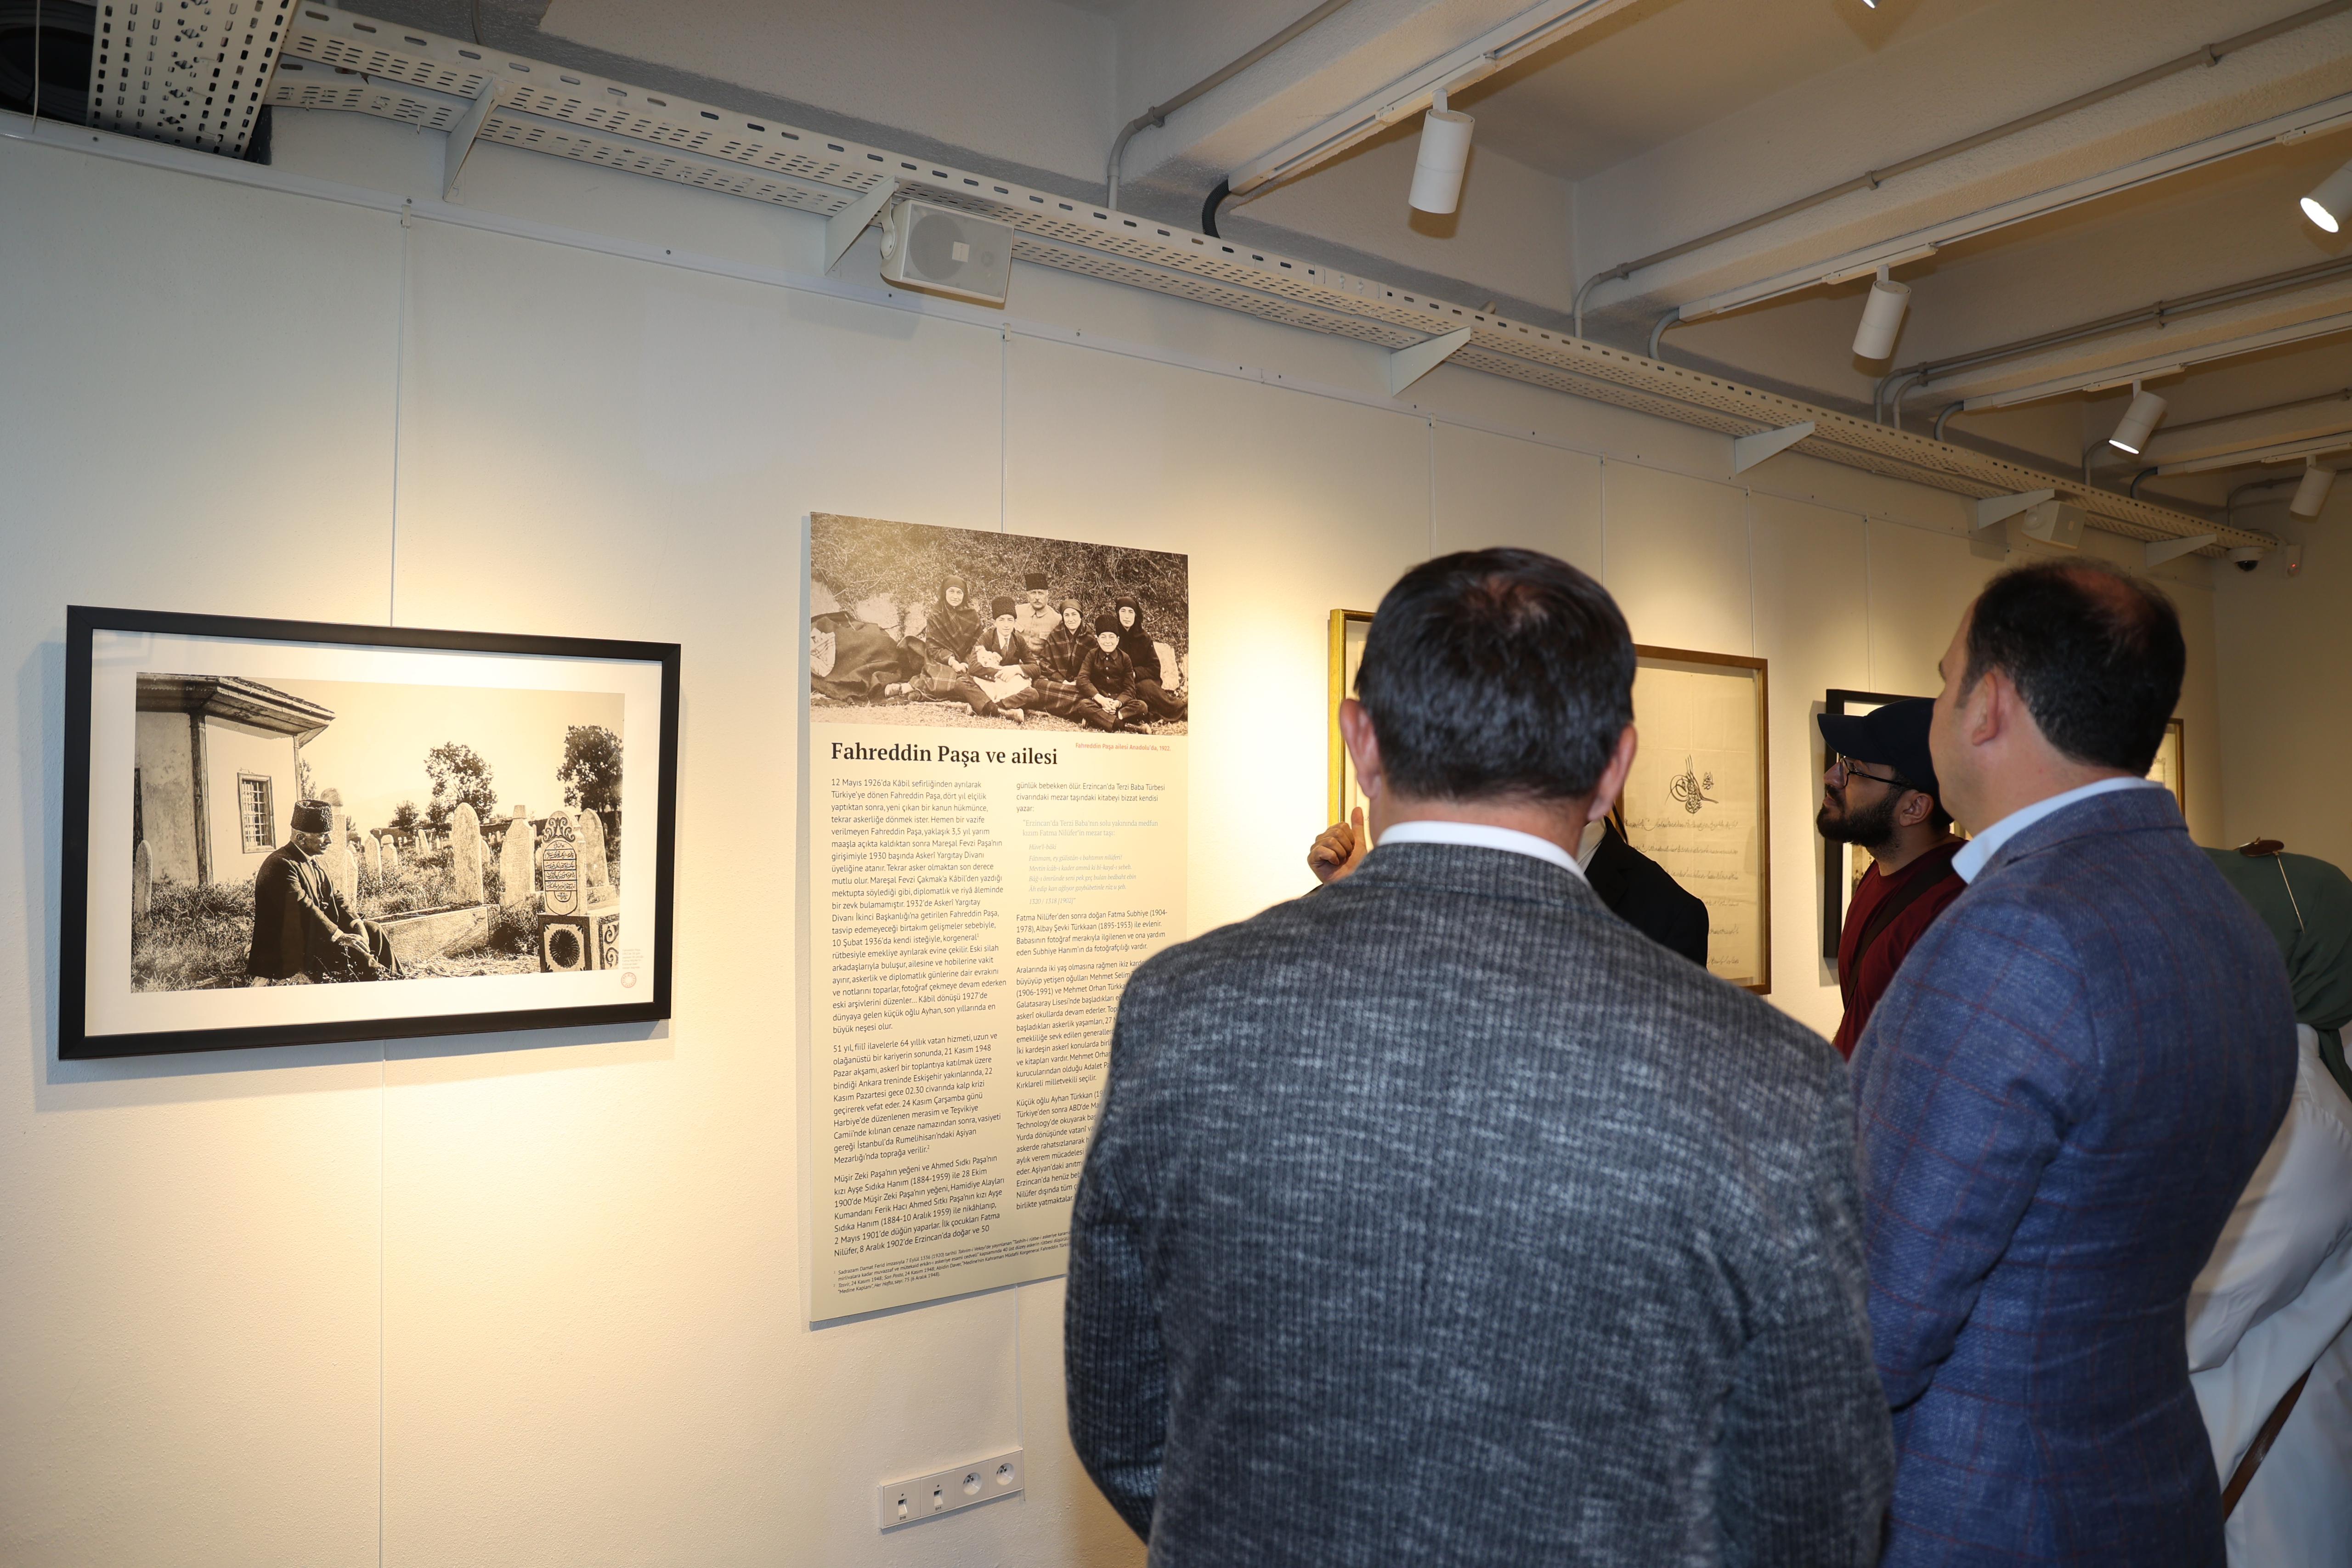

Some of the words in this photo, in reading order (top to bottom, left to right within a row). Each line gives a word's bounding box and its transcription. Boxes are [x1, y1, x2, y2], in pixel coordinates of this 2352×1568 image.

[831, 742, 932, 761] Fahreddin
[938, 745, 980, 767] Paşa
[985, 751, 1006, 763] ve
[1011, 747, 1057, 764] ailesi
[842, 778, 862, 788] Mayıs
[911, 780, 952, 789] sefirliğinden
[954, 781, 981, 789] ayrılarak
[1016, 782, 1037, 790] günlük
[926, 791, 942, 801] Paşa,
[958, 792, 966, 801] yıl
[967, 792, 986, 801] elçilik
[1070, 794, 1096, 802] taşındaki
[1098, 794, 1119, 802] kitabeyi
[870, 876, 897, 886] Mareşal
[980, 874, 1002, 883] yazdığı
[1088, 911, 1106, 920] doğan
[1126, 909, 1148, 918] Subhiye
[1149, 909, 1167, 918] (1904-
[1017, 925, 1035, 934] 1978),
[1035, 925, 1053, 933] Albay
[1054, 924, 1069, 933] Şevki
[1098, 921, 1133, 931] (1895-1953)
[832, 950, 866, 960] rütbesiyle
[867, 949, 898, 958] emekliye
[899, 948, 927, 958] ayrılarak
[948, 946, 969, 955] çekilir.
[1016, 987, 1053, 998] (1906-1991)
[832, 1000, 846, 1009] eski
[848, 998, 881, 1010] arşivlerini
[883, 997, 917, 1005] düzenler...
[918, 994, 936, 1003] Kâbil
[937, 993, 961, 1003] dönüşü
[833, 1054, 871, 1066] olağanüstü
[883, 1051, 912, 1061] kariyerin
[914, 1049, 943, 1058] sonunda,
[975, 1044, 991, 1052] 1948
[833, 1080, 857, 1090] bindiği
[858, 1079, 882, 1088] Ankara
[883, 1075, 911, 1085] treninde
[913, 1072, 942, 1083] Eskişehir
[943, 1068, 984, 1081] yakınlarında,
[1017, 1079, 1043, 1089] Kırklareli
[1045, 1075, 1077, 1086] milletvekili
[1079, 1074, 1097, 1083] seçilir.
[833, 1104, 865, 1117] geçirerek
[866, 1102, 883, 1111] vefat
[885, 1100, 901, 1109] eder.
[902, 1099, 910, 1107] 24
[933, 1094, 965, 1105] Çarşamba
[967, 1091, 983, 1102] günü
[1017, 1098, 1035, 1107] Küçük
[1036, 1096, 1050, 1105] oğlu
[1051, 1095, 1069, 1104] Ayhan
[1069, 1092, 1093, 1100] Türkkan
[1016, 1133, 1033, 1141] Yurda
[1035, 1128, 1068, 1139] dönüşünde
[1069, 1125, 1086, 1134] vatanî
[847, 1186, 863, 1195] Ayşe
[865, 1182, 885, 1191] Sıdıka
[887, 1179, 909, 1188] Hanım
[910, 1172, 950, 1186] (1884-1959)
[961, 1169, 970, 1178] 28
[972, 1168, 987, 1176] Ekim
[1016, 1201, 1037, 1210] birlikte
[1038, 1195, 1073, 1208] yatmaktalar.
[834, 1223, 854, 1232] Sıdıka
[857, 1220, 879, 1229] Hanım
[881, 1213, 911, 1227] (1884-10
[912, 1211, 931, 1220] Aralık
[933, 1207, 951, 1217] 1959)
[962, 1202, 996, 1213] nikâhlanıp,
[834, 1247, 858, 1257] Nilüfer,
[865, 1242, 885, 1252] Aralık
[952, 1229, 971, 1237] doğar
